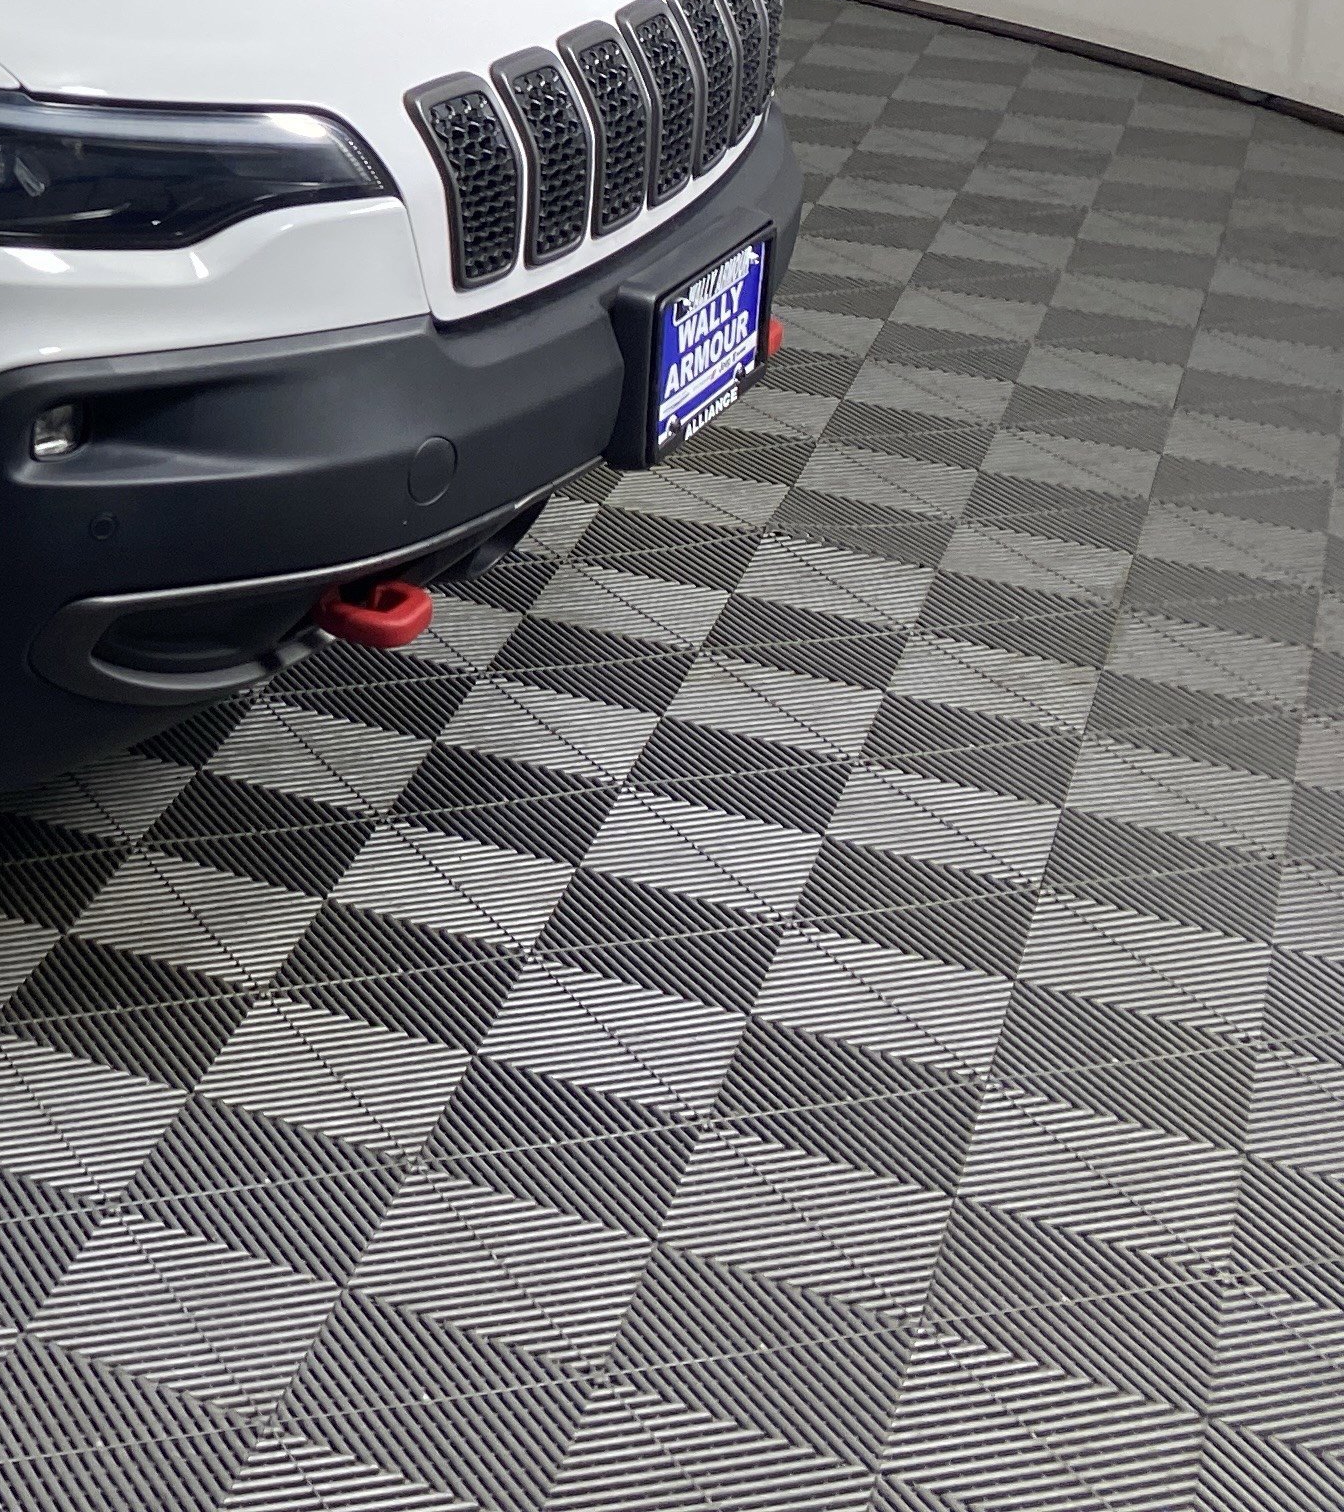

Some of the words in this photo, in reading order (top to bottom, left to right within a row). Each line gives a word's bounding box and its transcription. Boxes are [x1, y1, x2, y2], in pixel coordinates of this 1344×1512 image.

[678, 281, 744, 353] WALLY
[664, 310, 749, 399] ARMOUR
[685, 387, 739, 440] ALLIANCE
